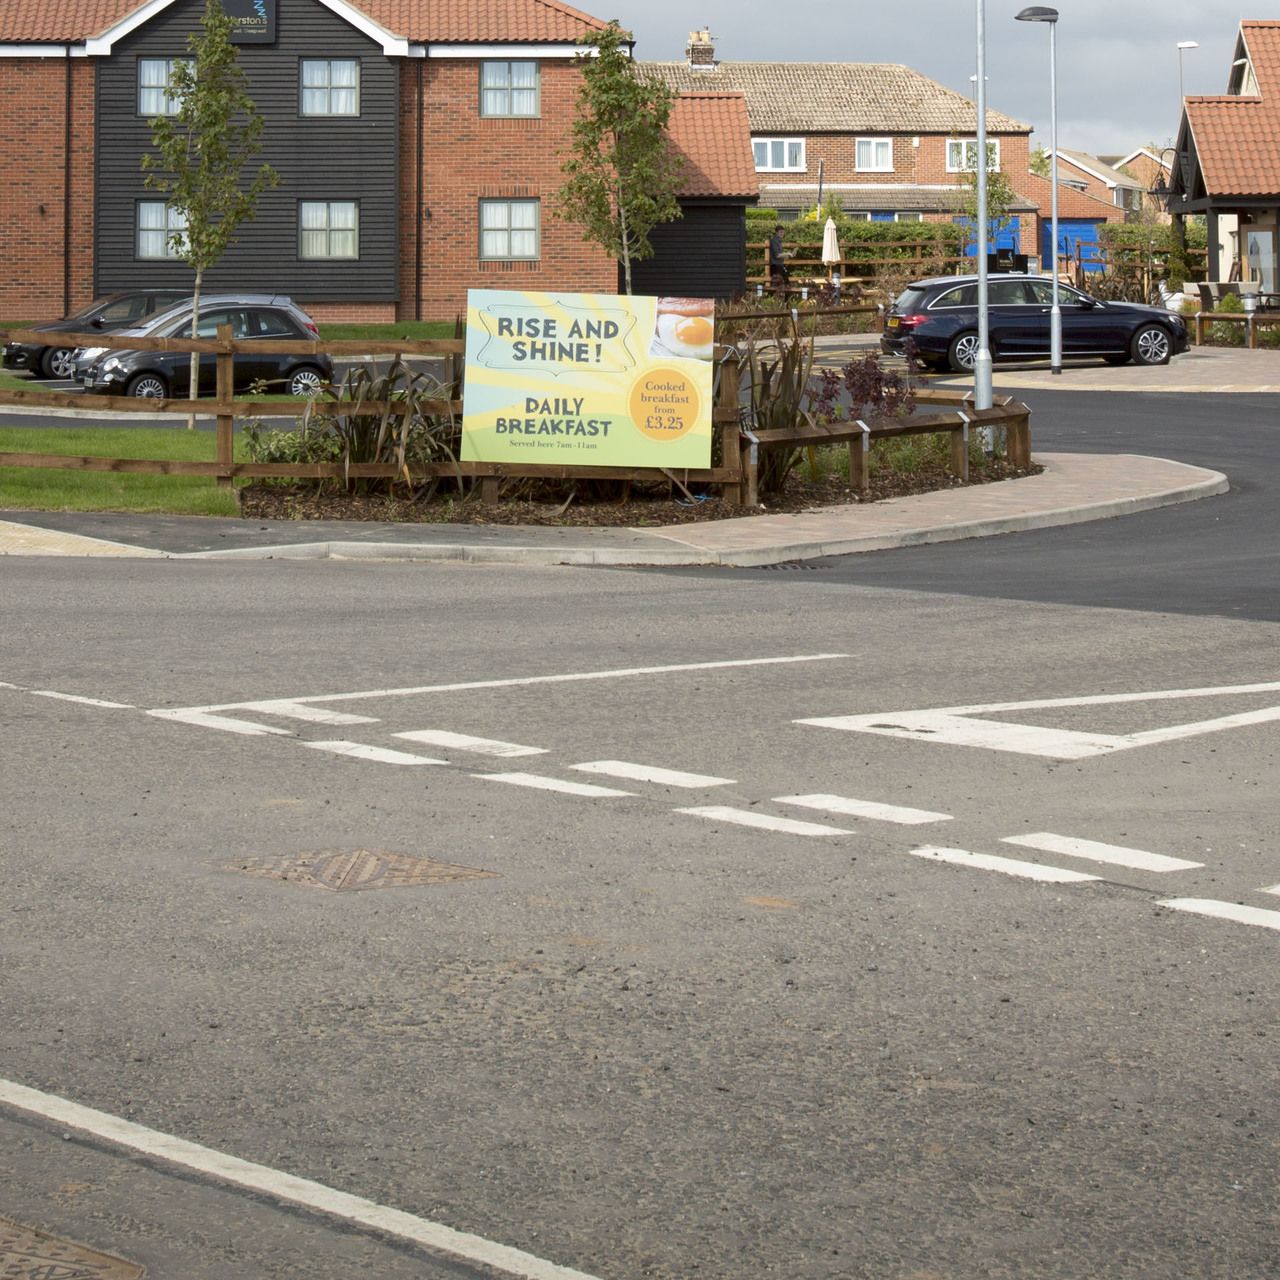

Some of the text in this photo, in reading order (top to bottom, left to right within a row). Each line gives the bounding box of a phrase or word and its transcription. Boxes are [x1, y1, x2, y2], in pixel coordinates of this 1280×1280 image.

[497, 317, 619, 339] RISE AND
[512, 341, 602, 363] SHINE!
[645, 381, 686, 392] Cooked
[525, 397, 584, 416] DAILY
[641, 393, 689, 405] breakfast
[654, 405, 676, 415] from
[495, 418, 612, 438] BREAKFAST
[645, 416, 684, 431] £3.25
[509, 440, 536, 448] Served
[537, 440, 554, 449] here
